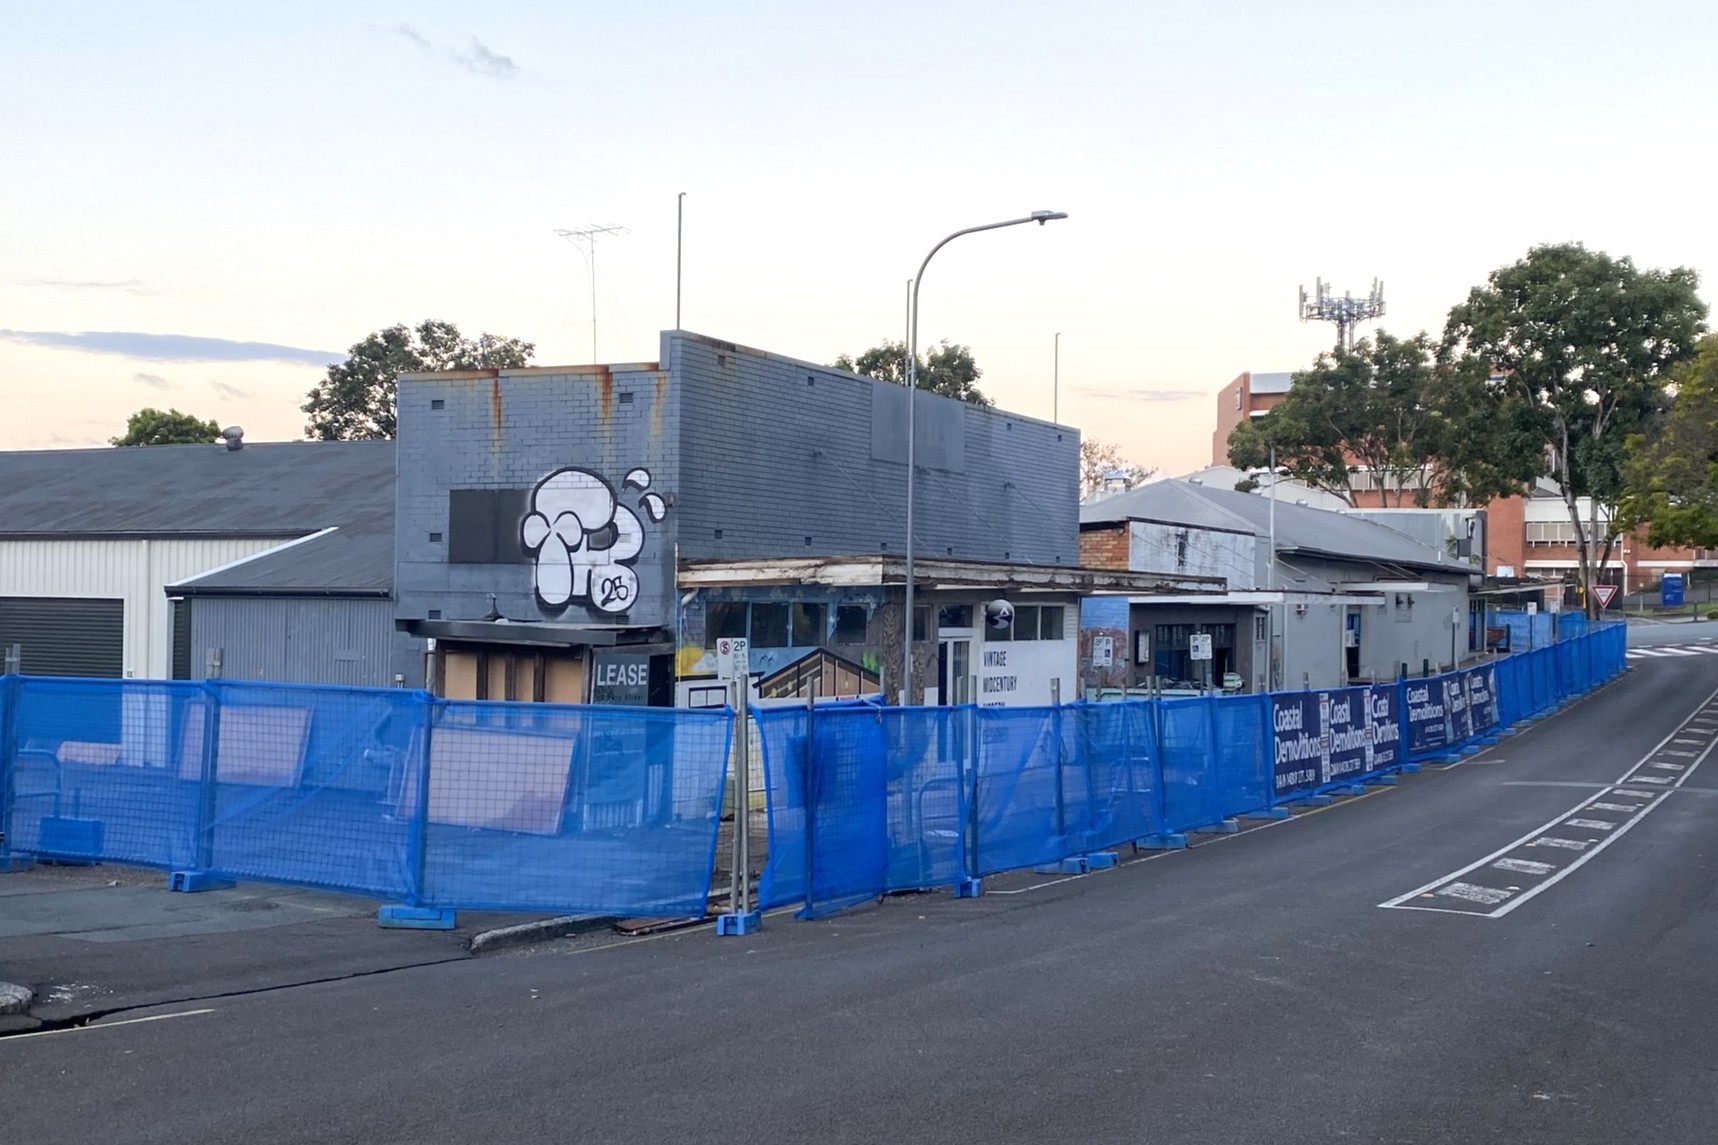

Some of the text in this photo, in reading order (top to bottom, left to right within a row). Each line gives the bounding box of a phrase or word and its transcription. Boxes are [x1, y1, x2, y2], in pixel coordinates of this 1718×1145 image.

[601, 576, 628, 607] 25
[733, 641, 746, 651] 2P
[983, 651, 1006, 667] VINTAGE
[596, 664, 647, 686] LEASE
[983, 675, 1017, 693] MIDCENTURY
[1406, 684, 1429, 704] Coastal
[1273, 700, 1303, 732] Coastal
[1274, 731, 1321, 765] Demolitions
